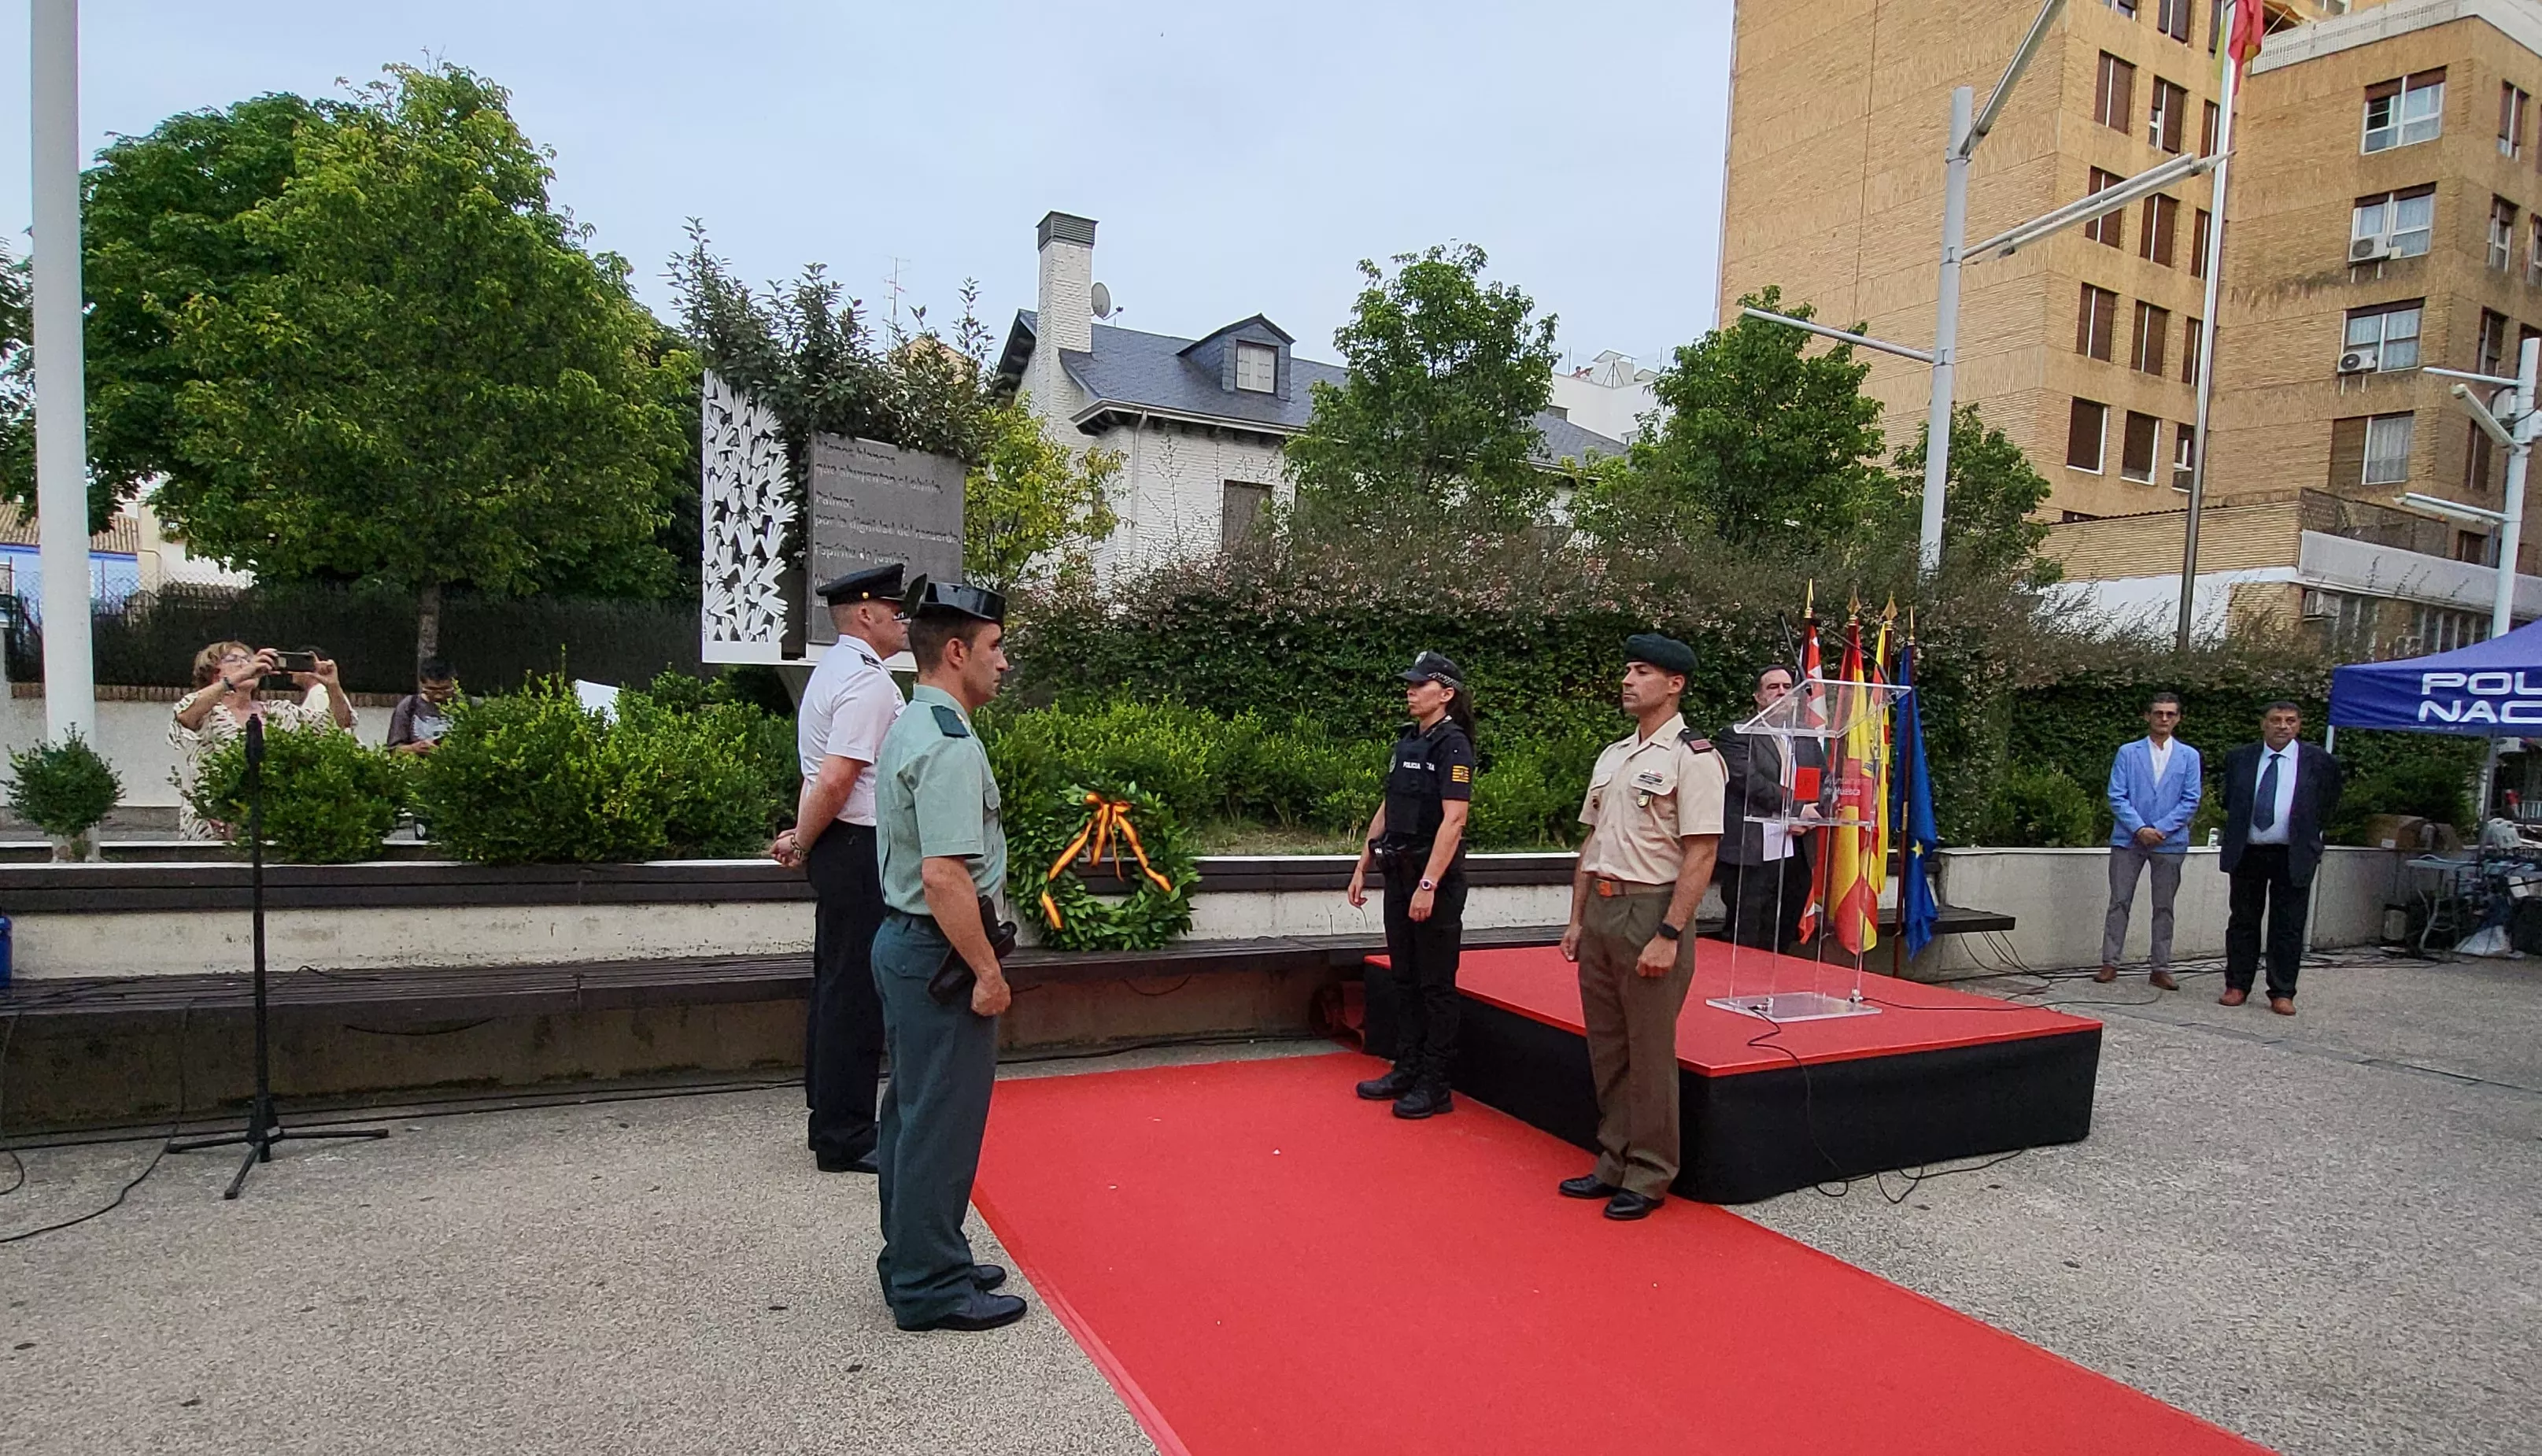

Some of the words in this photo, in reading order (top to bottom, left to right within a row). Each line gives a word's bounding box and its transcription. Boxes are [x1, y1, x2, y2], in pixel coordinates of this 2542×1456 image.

[815, 463, 837, 478] que
[815, 490, 855, 509] Palmas
[815, 513, 835, 528] por
[849, 516, 895, 536] dignidad
[897, 523, 913, 538] del
[859, 547, 872, 561] de
